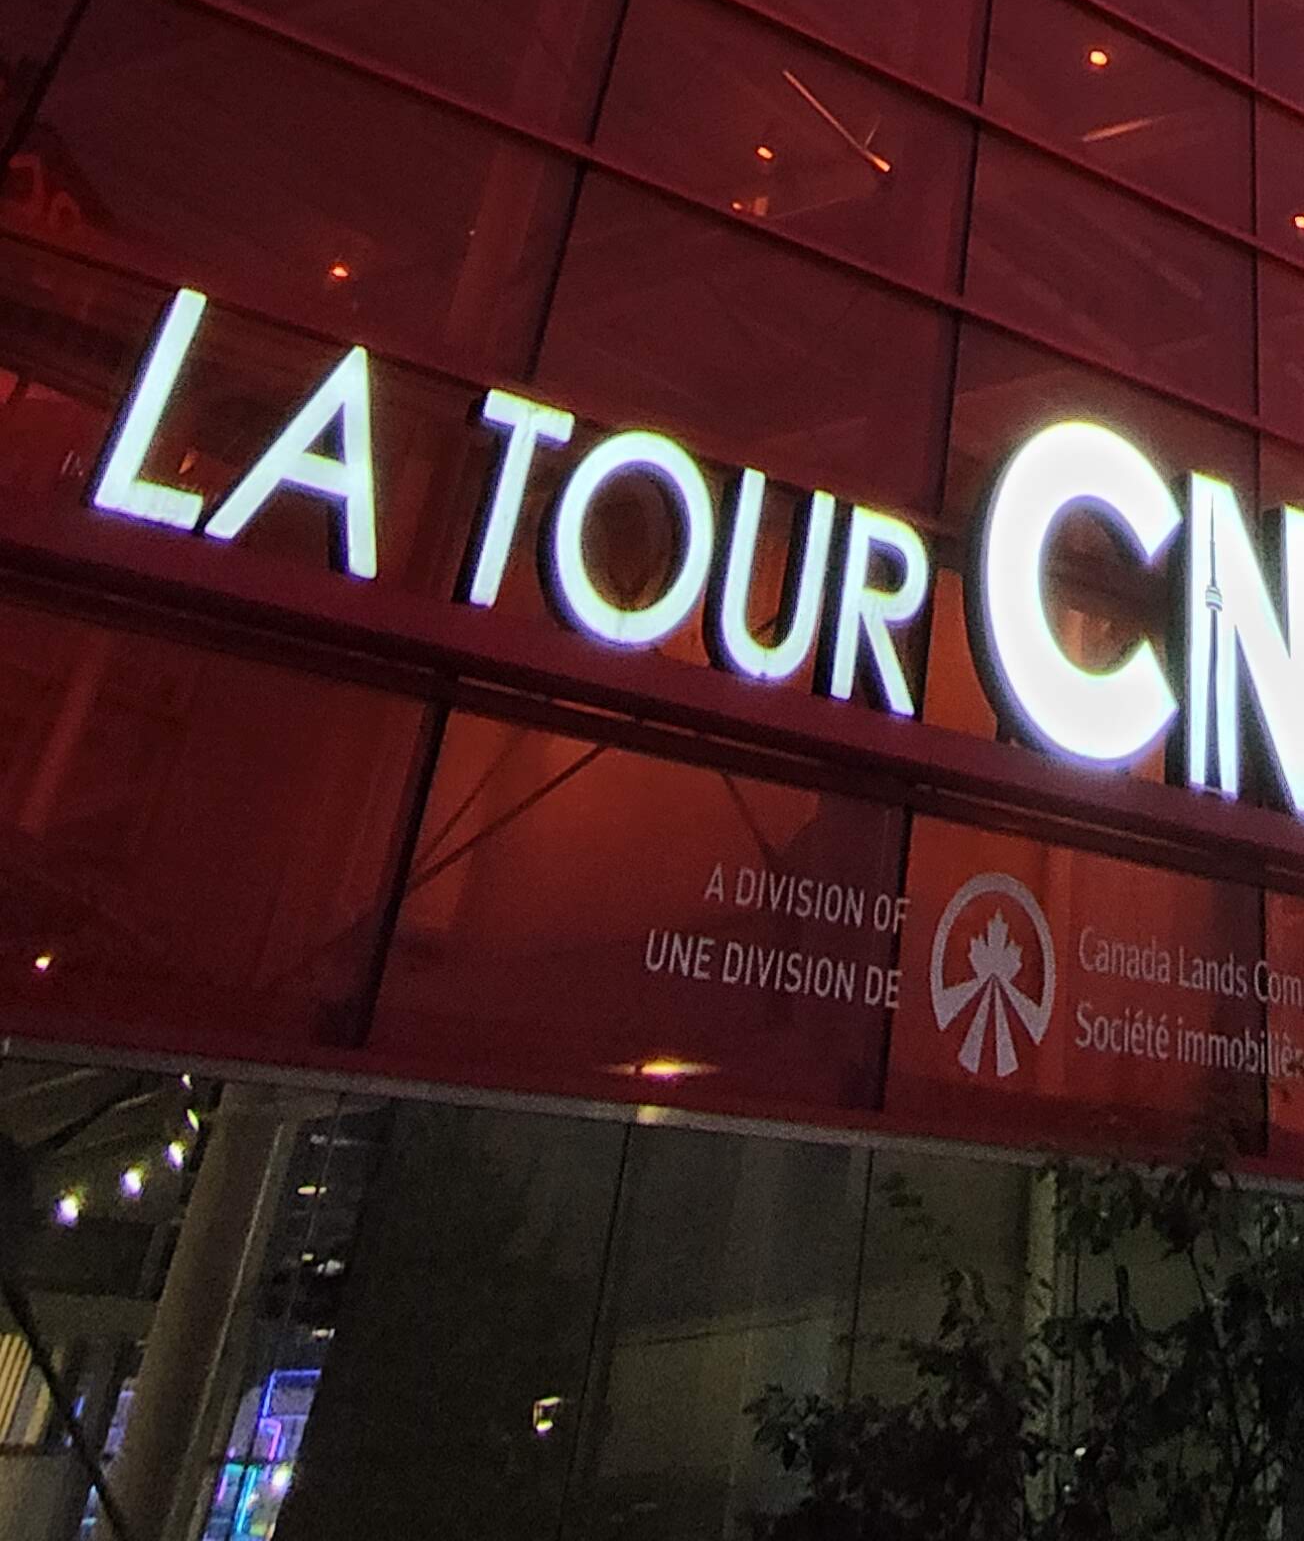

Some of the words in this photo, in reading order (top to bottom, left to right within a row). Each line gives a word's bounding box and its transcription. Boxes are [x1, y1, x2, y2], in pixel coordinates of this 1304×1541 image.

[93, 287, 377, 580] LA
[469, 388, 929, 717] TOUR
[704, 862, 724, 902] A
[735, 867, 865, 928] DIVISION
[873, 893, 911, 935] OF
[644, 928, 716, 980] UNE
[722, 940, 856, 1003] DIVISION
[864, 965, 903, 1009] DE
[1078, 926, 1171, 984] Canada
[1179, 945, 1248, 1000] Lands
[1075, 1001, 1170, 1060] Société
